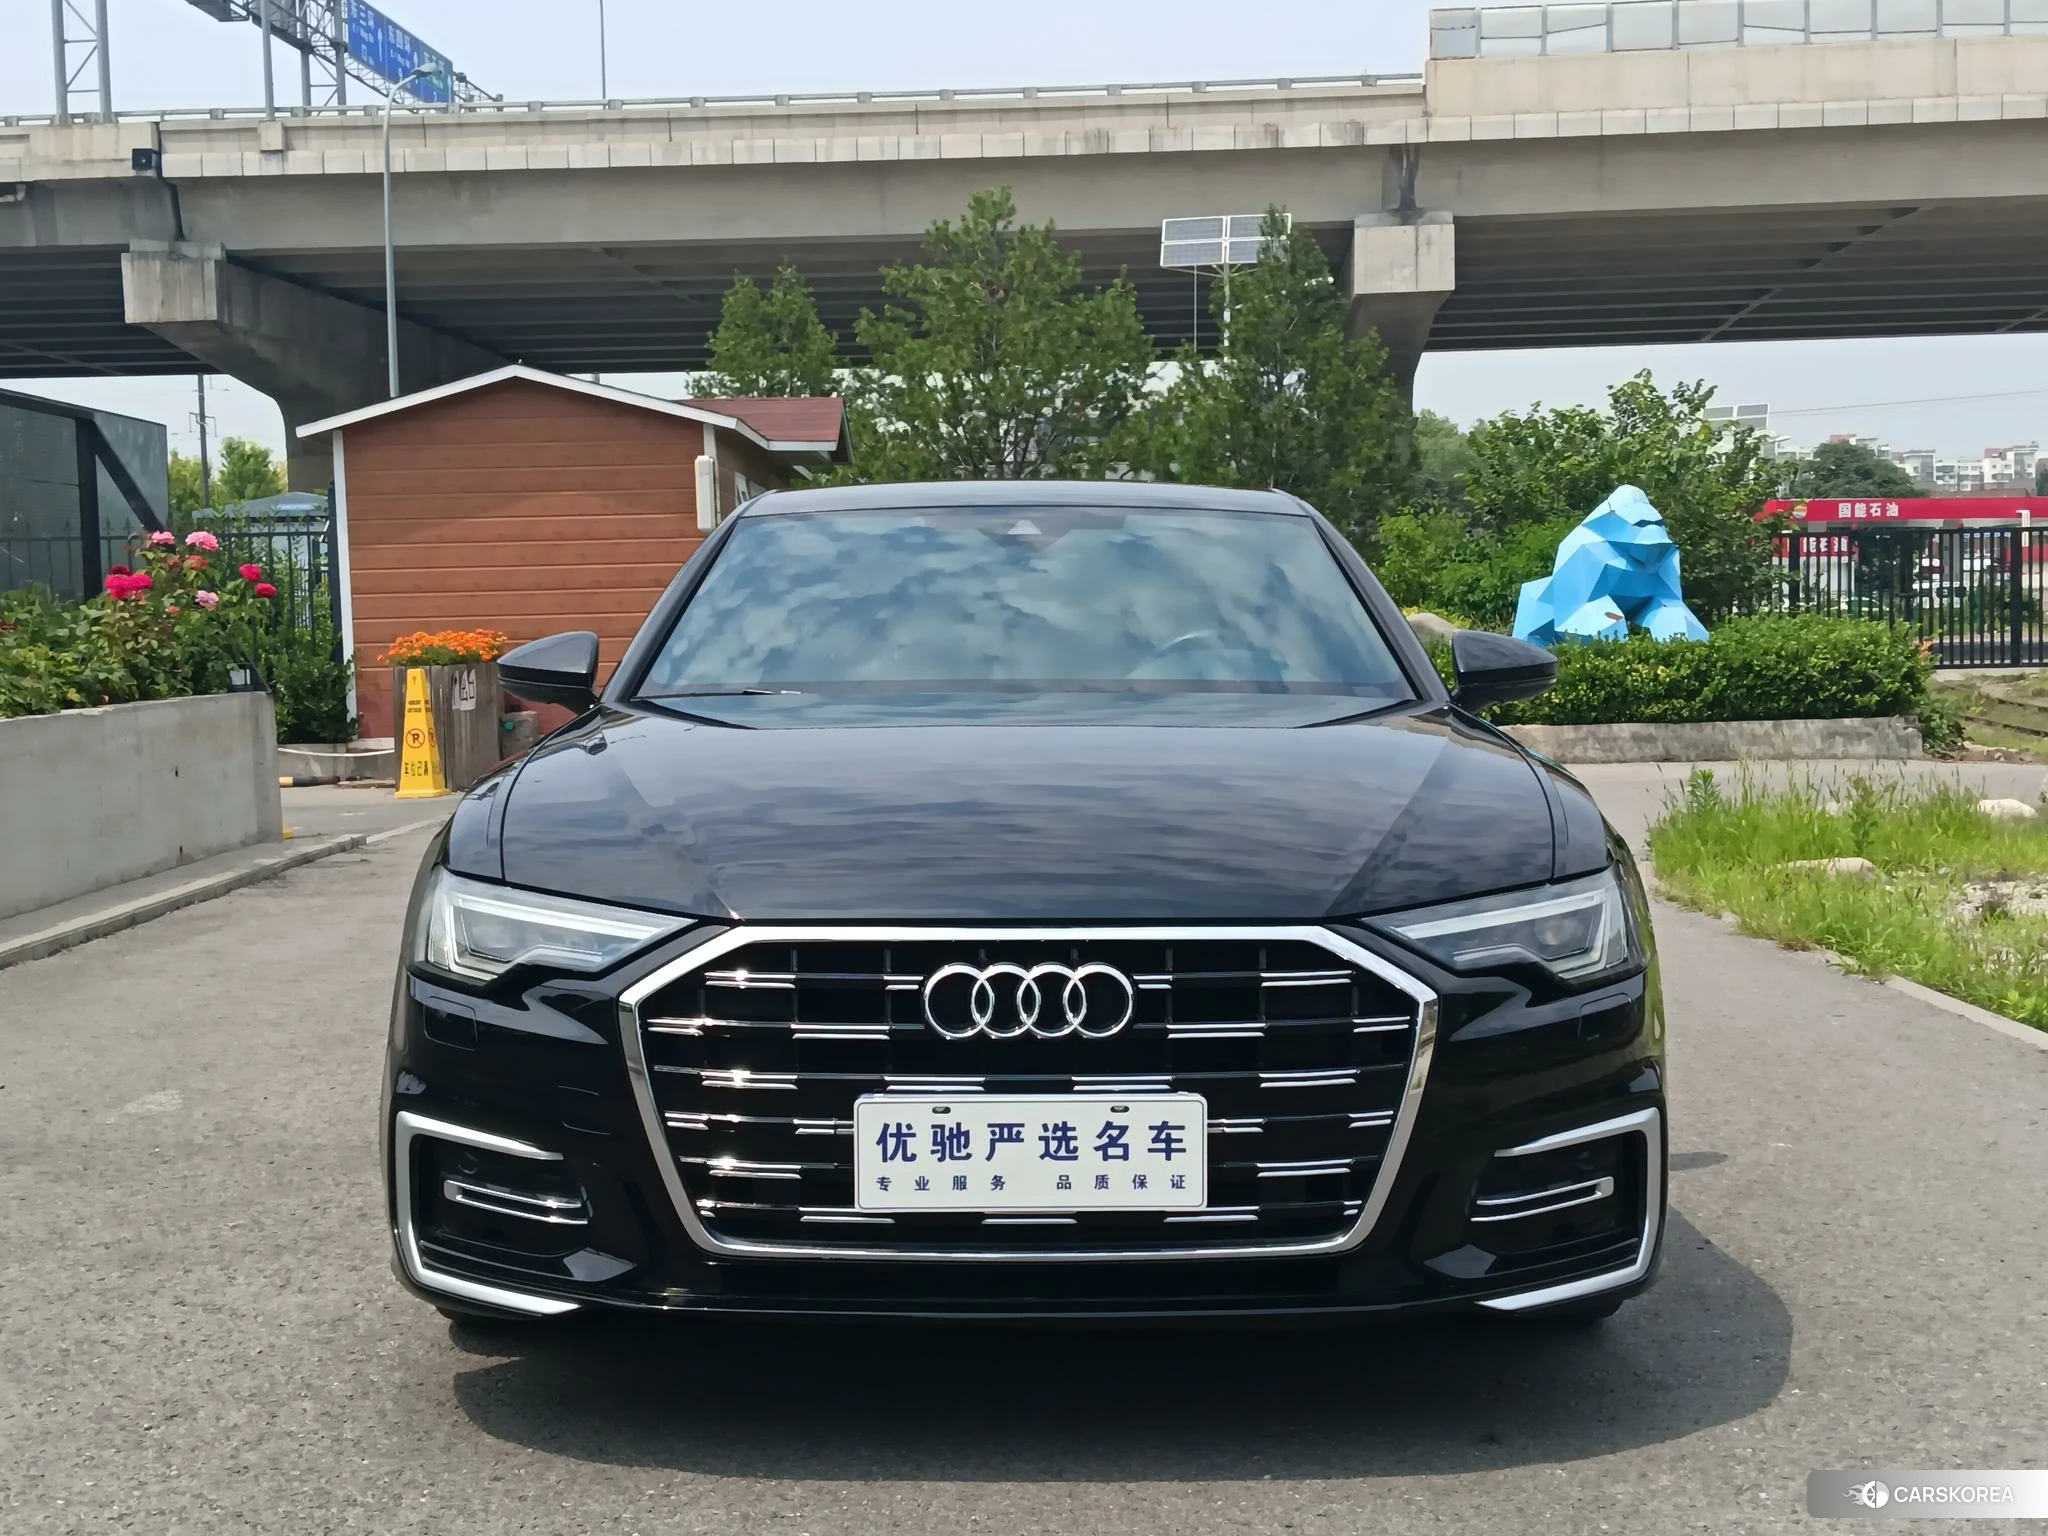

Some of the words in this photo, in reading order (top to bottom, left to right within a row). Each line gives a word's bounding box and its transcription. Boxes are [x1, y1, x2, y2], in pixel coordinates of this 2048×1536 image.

[1838, 502, 1899, 518] 国能石油
[875, 1120, 1187, 1163] 优驰严选名车
[875, 1175, 1006, 1192] 专业服务
[1056, 1174, 1187, 1191] 品质保证
